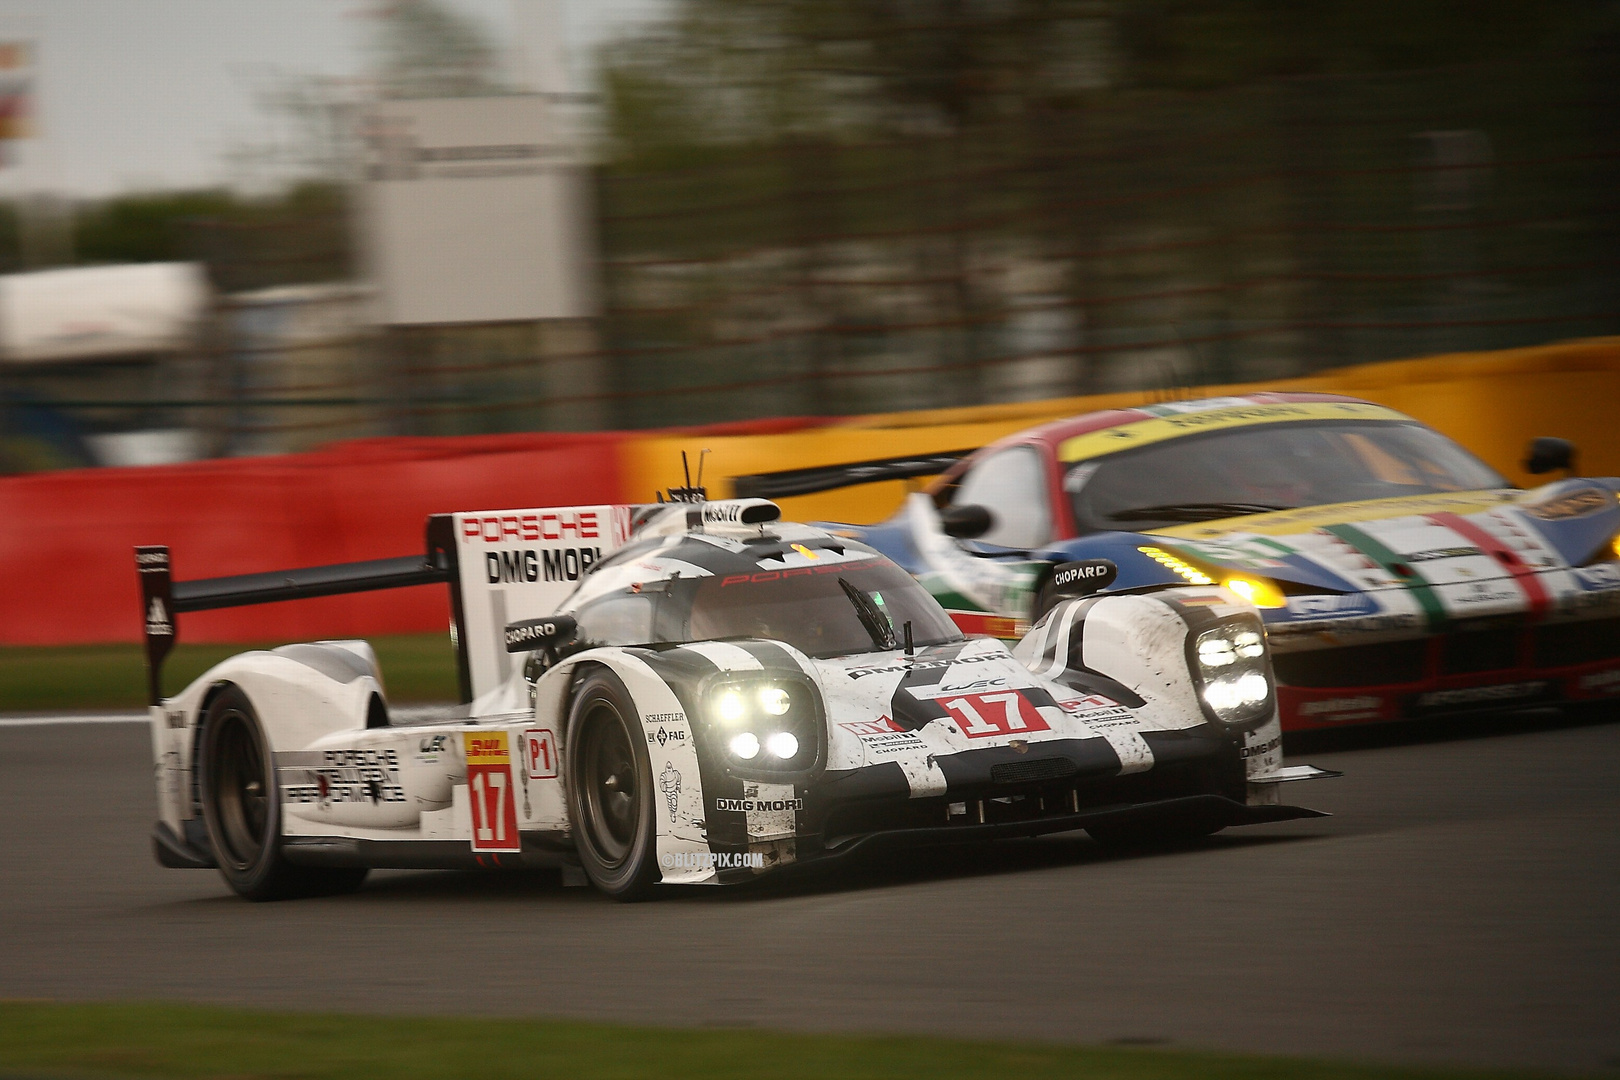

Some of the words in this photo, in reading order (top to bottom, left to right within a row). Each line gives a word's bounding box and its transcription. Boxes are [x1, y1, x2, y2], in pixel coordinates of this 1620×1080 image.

[462, 512, 599, 544] PORSCHE
[486, 550, 538, 584] DMG
[541, 547, 601, 582] MOR
[1054, 564, 1108, 586] CHOPARD
[505, 623, 556, 644] CHOPARD
[941, 677, 1006, 692] WEC
[1058, 697, 1105, 710] P1
[645, 712, 684, 723] SCHAEFFLER
[945, 692, 1027, 735] 17
[1073, 709, 1113, 719] Mobil
[1088, 719, 1140, 730] CHOPARD
[668, 730, 685, 741] FAG
[861, 733, 902, 743] Mobil
[466, 739, 509, 757] DHL
[530, 738, 551, 770] P1
[875, 744, 928, 755] CHOPARD
[1241, 743, 1267, 759] DMG
[324, 749, 400, 766] PORSCHE
[472, 772, 507, 841] 17
[717, 799, 754, 811] DMG
[756, 799, 803, 812] MORI
